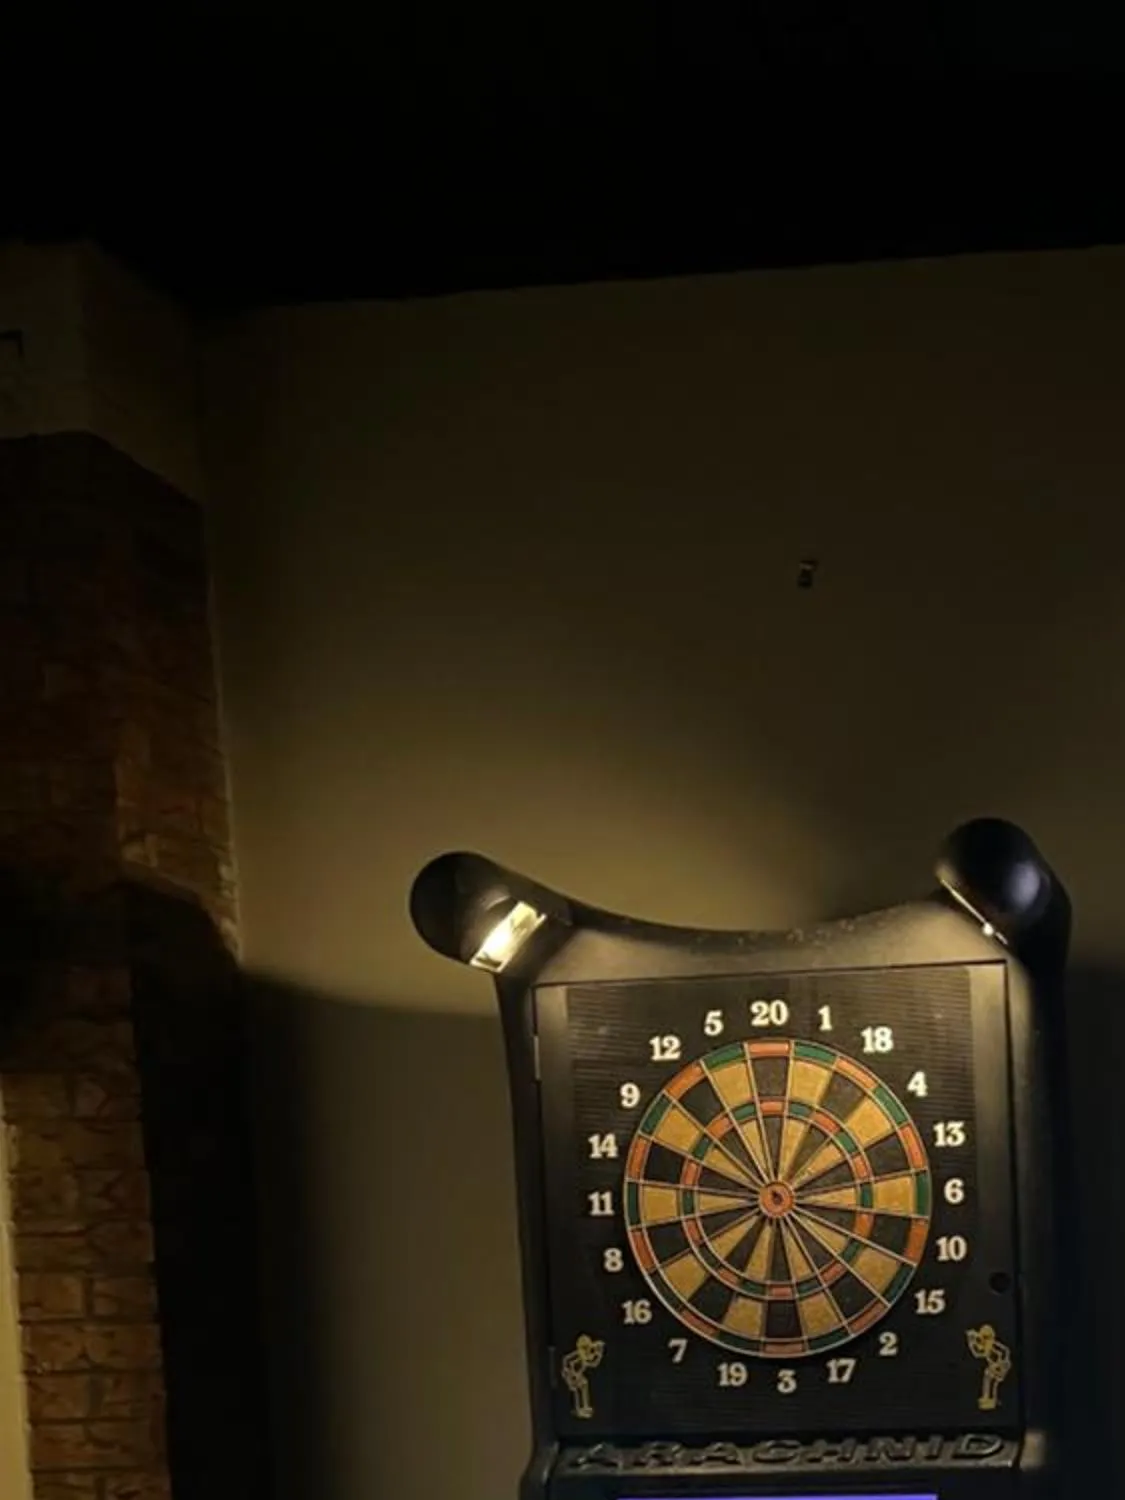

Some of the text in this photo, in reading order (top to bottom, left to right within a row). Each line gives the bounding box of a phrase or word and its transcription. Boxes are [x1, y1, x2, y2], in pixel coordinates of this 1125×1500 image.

[704, 1010, 724, 1036] 5
[750, 999, 789, 1027] 20
[818, 1005, 833, 1031] 1
[649, 1035, 681, 1061] 12
[861, 1026, 894, 1053] 18
[620, 1082, 641, 1108] 9
[907, 1071, 928, 1097] 4
[588, 1133, 618, 1159] 14
[933, 1121, 966, 1147] 13
[588, 1191, 614, 1216] 11
[944, 1178, 964, 1204] 6
[604, 1247, 624, 1272] 8
[936, 1235, 967, 1261] 10
[622, 1299, 653, 1324] 16
[915, 1289, 945, 1314] 15
[668, 1338, 688, 1363] 7
[879, 1331, 897, 1356] 2
[718, 1362, 748, 1387] 19
[777, 1369, 797, 1394] 3
[827, 1358, 856, 1383] 17
[573, 1433, 1004, 1469] ARACHNID
